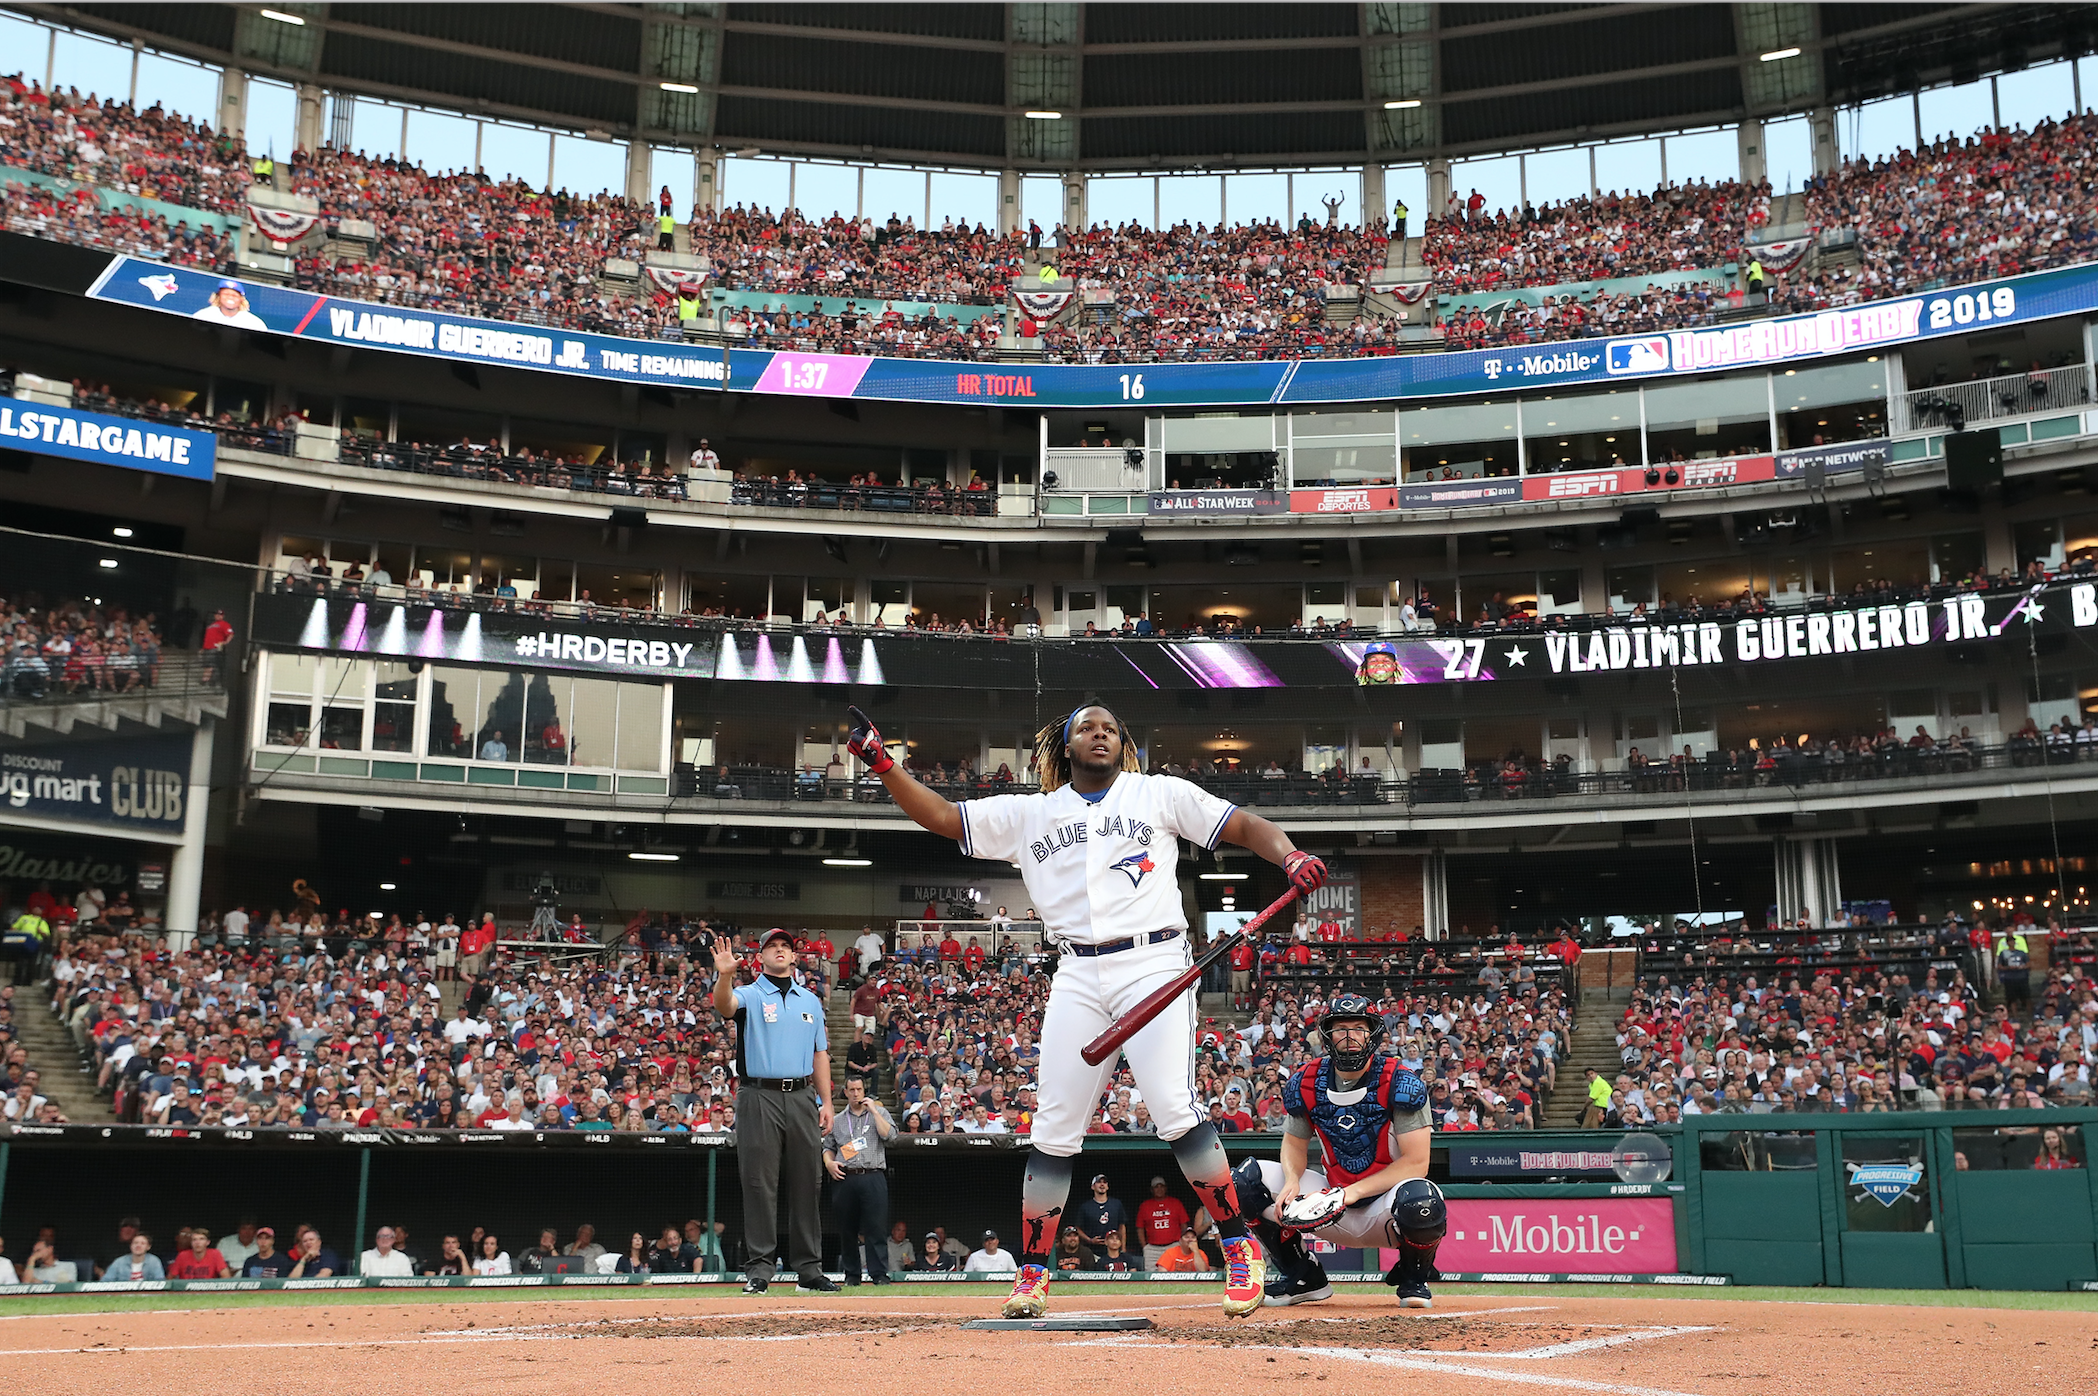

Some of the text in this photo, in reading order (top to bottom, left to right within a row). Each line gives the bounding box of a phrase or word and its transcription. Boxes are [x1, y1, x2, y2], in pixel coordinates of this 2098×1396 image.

[1668, 287, 2016, 371] HOME RUN DERBY 2019
[330, 307, 590, 369] VLADIMIR GUERRERO JR.
[600, 350, 639, 373] TIME
[781, 361, 829, 389] 1:37
[957, 373, 1037, 397] HR TOTAL
[1119, 373, 1145, 400] 16
[1684, 461, 1737, 480] ESPN
[1549, 474, 1618, 497] ESPN
[1684, 475, 1736, 486] RADIO
[1323, 491, 1368, 502] ESPN
[1498, 488, 1516, 496] 2019
[1318, 502, 1371, 511] DEPORTES
[1443, 639, 1486, 679] 27
[1545, 621, 1724, 673] VLADIMIR
[1736, 601, 1930, 661] GUERRERO
[1943, 593, 2002, 642] JR.
[515, 632, 694, 667] #HRDERBY
[3, 754, 64, 772] DISCOUNT
[34, 774, 101, 804] mart
[111, 766, 183, 821] CLUB
[1096, 815, 1154, 846] JAYS
[1030, 822, 1088, 863] BLUE
[756, 883, 785, 897] JOSS
[914, 887, 936, 901] NAP
[1307, 886, 1355, 914] HOME
[1161, 931, 1171, 940] 27
[585, 1135, 610, 1143] @MLB
[914, 1138, 938, 1146] @MLB
[1519, 1152, 1553, 1169] HOME
[1552, 1152, 1580, 1169] RUN
[1856, 1171, 1915, 1181] PROGRESSIVE
[1610, 1184, 1652, 1194] #HRDERBY
[1873, 1185, 1902, 1194] FIELD
[1154, 1221, 1170, 1229] CLE
[469, 1277, 544, 1286] PROGRESSIVE FIELD
[562, 1276, 630, 1284] PROGRESSIVE FIELD
[649, 1274, 719, 1284] PROGRESSIVE FIELD
[1192, 1272, 1217, 1280] FIELD
[1524, 1274, 1550, 1282] FIELD
[1654, 1275, 1726, 1284] PROGRESSIVE FIELD
